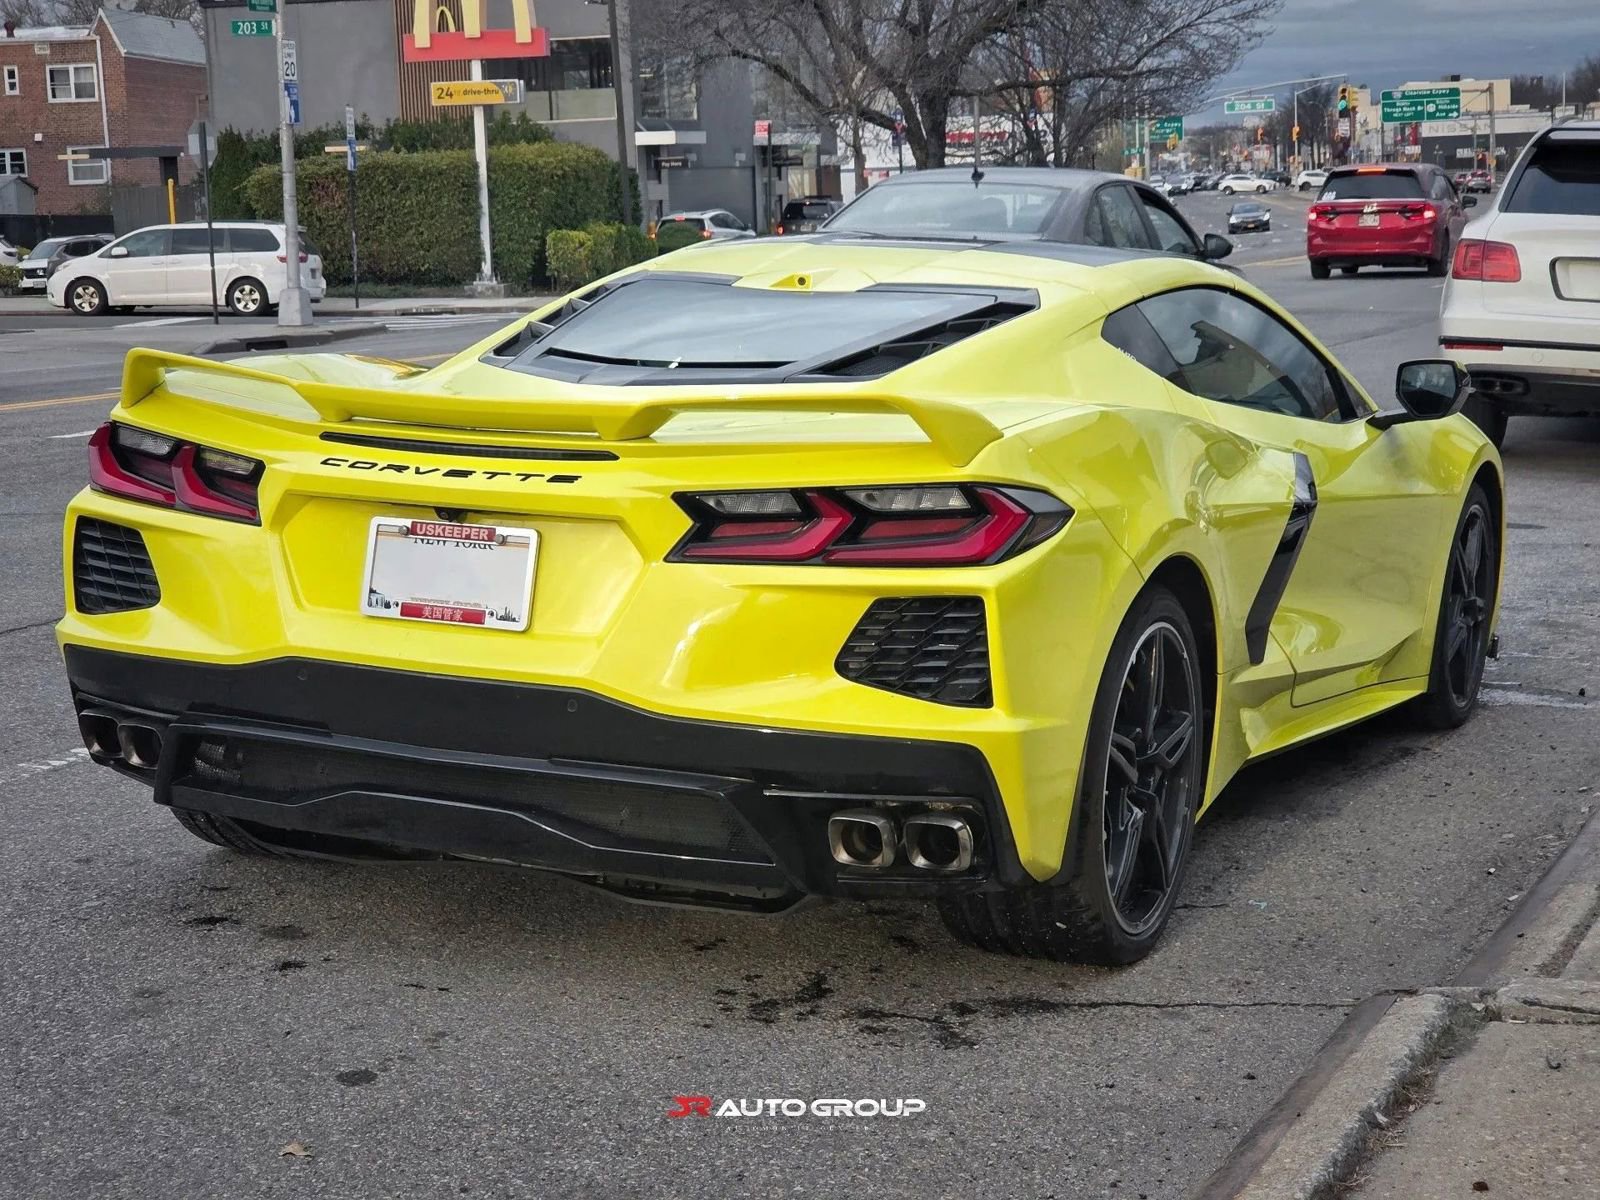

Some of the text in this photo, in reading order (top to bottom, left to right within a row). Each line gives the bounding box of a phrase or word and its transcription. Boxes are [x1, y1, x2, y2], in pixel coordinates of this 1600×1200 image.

[237, 22, 257, 35] 203
[284, 62, 296, 77] 20
[437, 87, 454, 100] 24
[462, 88, 500, 97] drive-thru
[1234, 102, 1252, 111] 204
[319, 457, 583, 484] CORVETTE
[416, 523, 489, 541] USKEEPER
[422, 606, 464, 621] 美国管家
